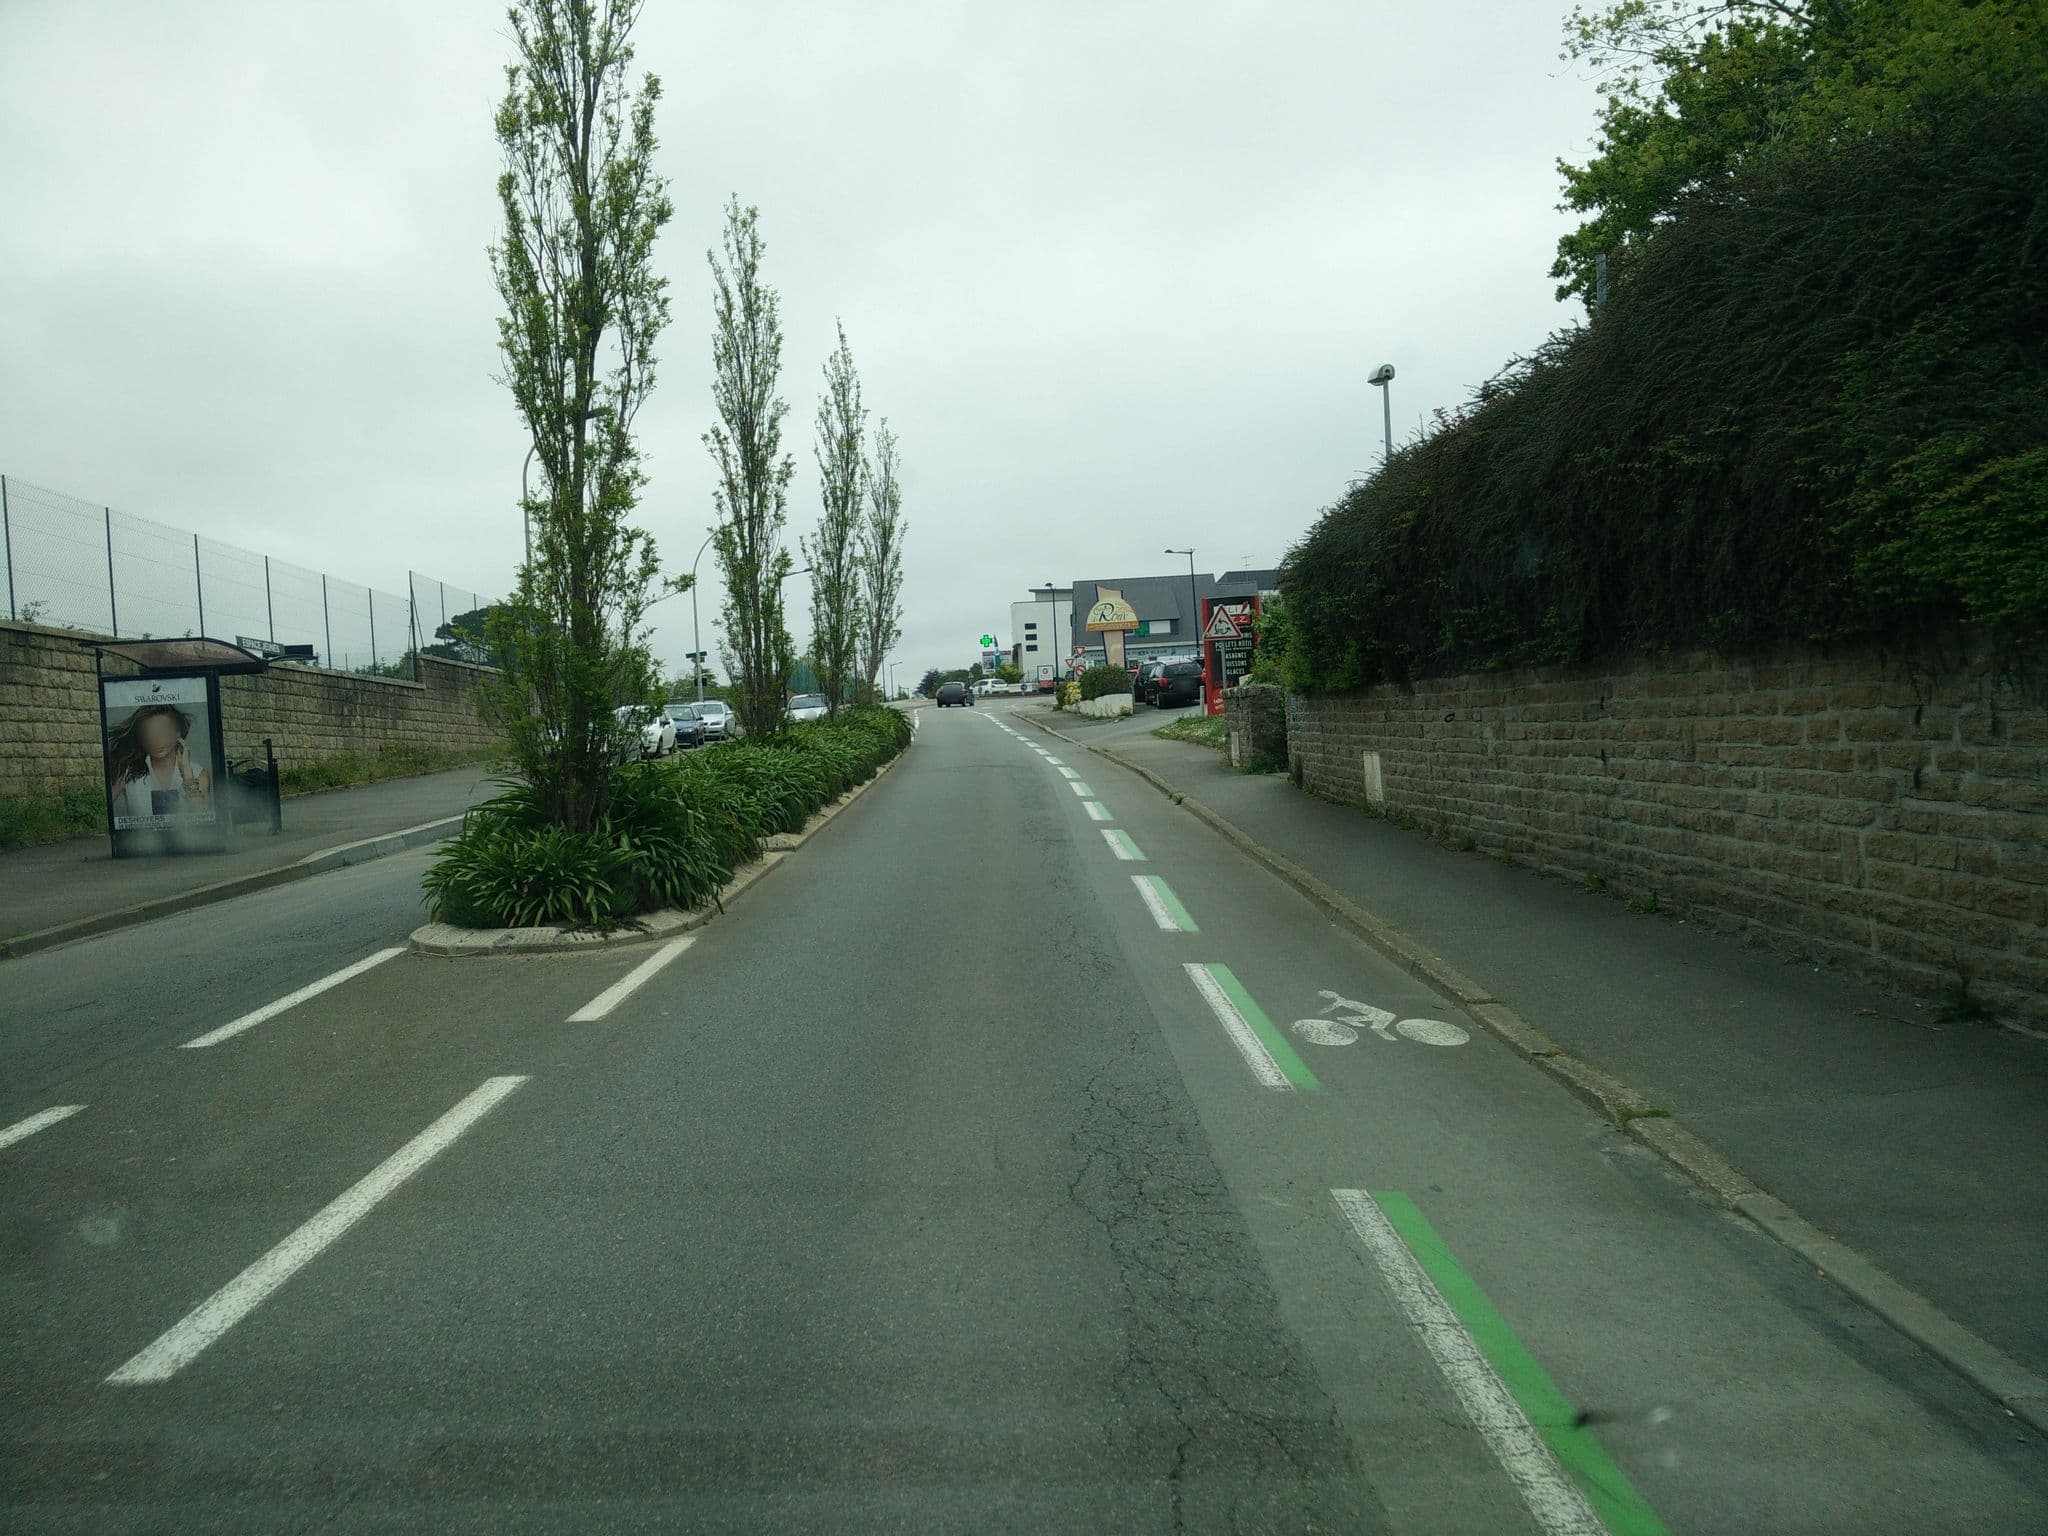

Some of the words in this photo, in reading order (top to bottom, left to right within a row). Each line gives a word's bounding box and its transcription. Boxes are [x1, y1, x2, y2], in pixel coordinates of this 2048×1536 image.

[1215, 641, 1237, 649] POLETS
[1224, 660, 1247, 668] OISSONS
[134, 693, 181, 704] SWAROVSKI
